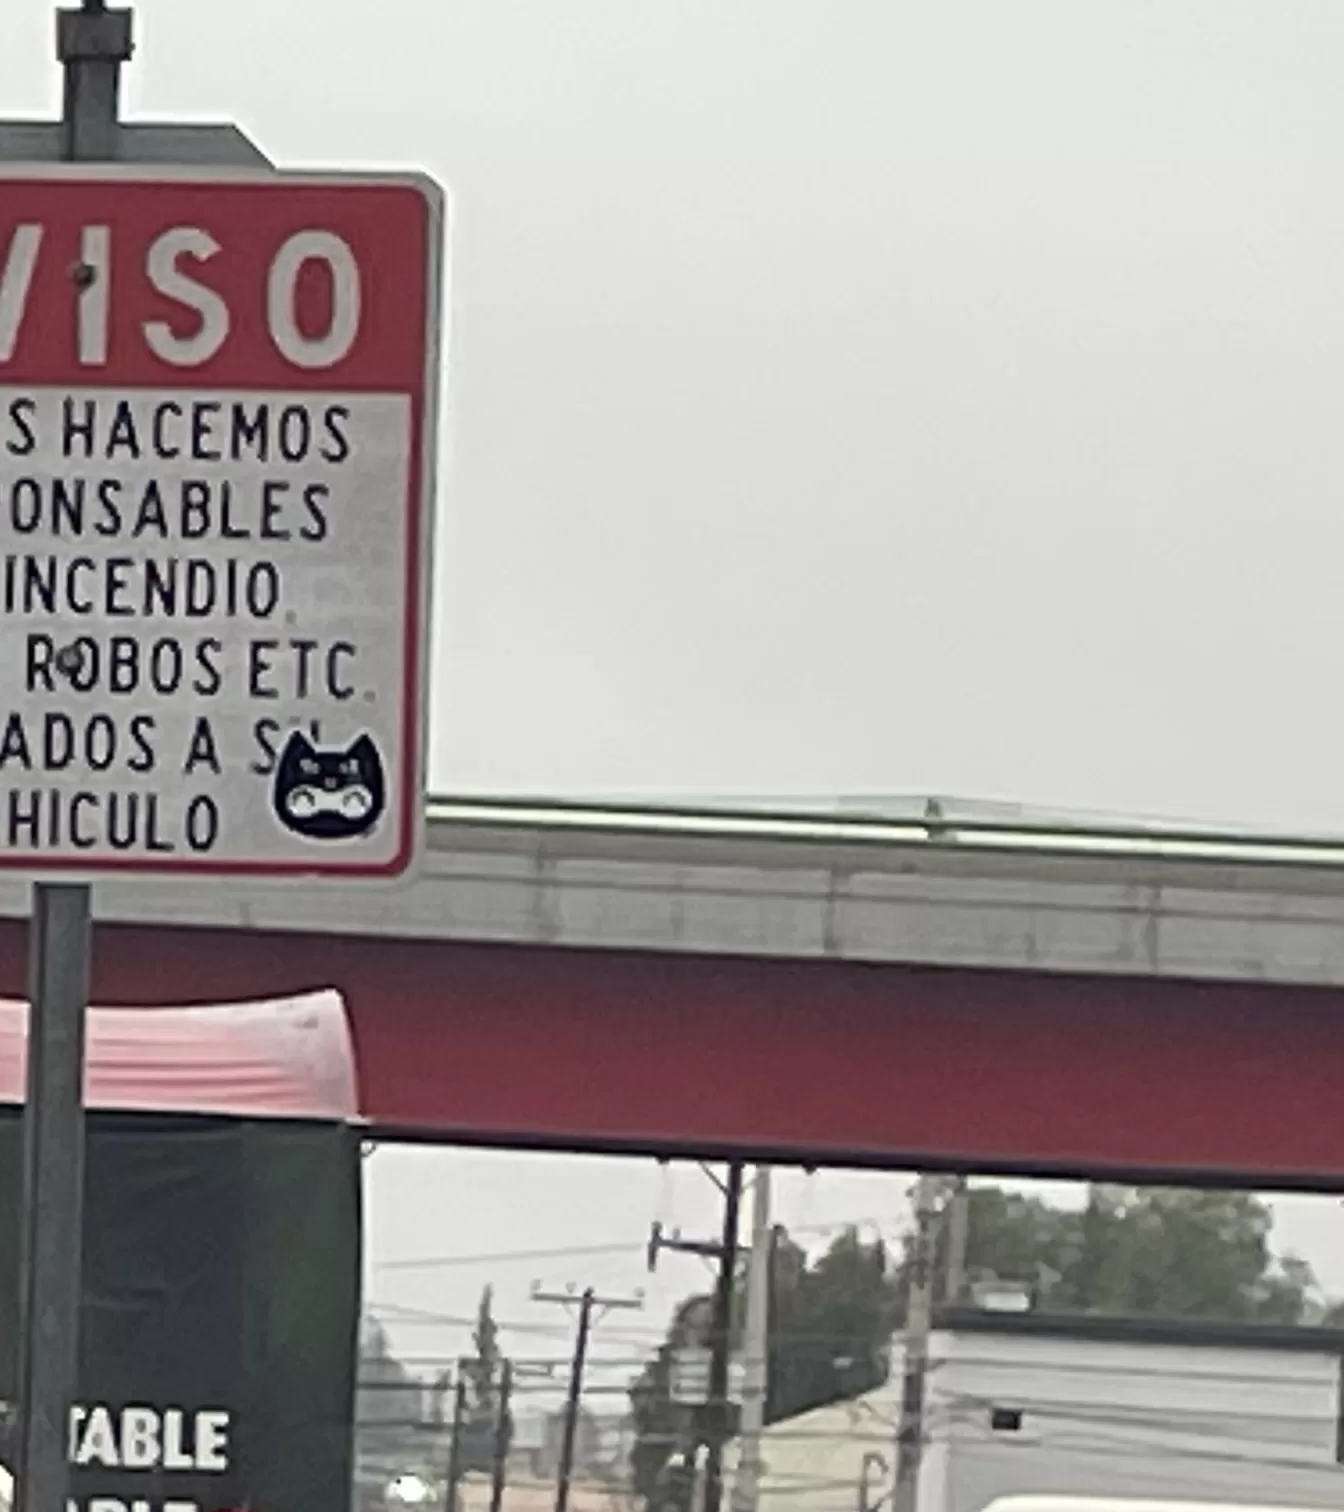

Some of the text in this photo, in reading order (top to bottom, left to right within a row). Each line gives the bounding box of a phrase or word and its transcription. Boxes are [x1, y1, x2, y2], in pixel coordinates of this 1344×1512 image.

[62, 399, 352, 463] HACEMOS
[26, 634, 223, 696] ROBOS
[184, 716, 223, 776] A
